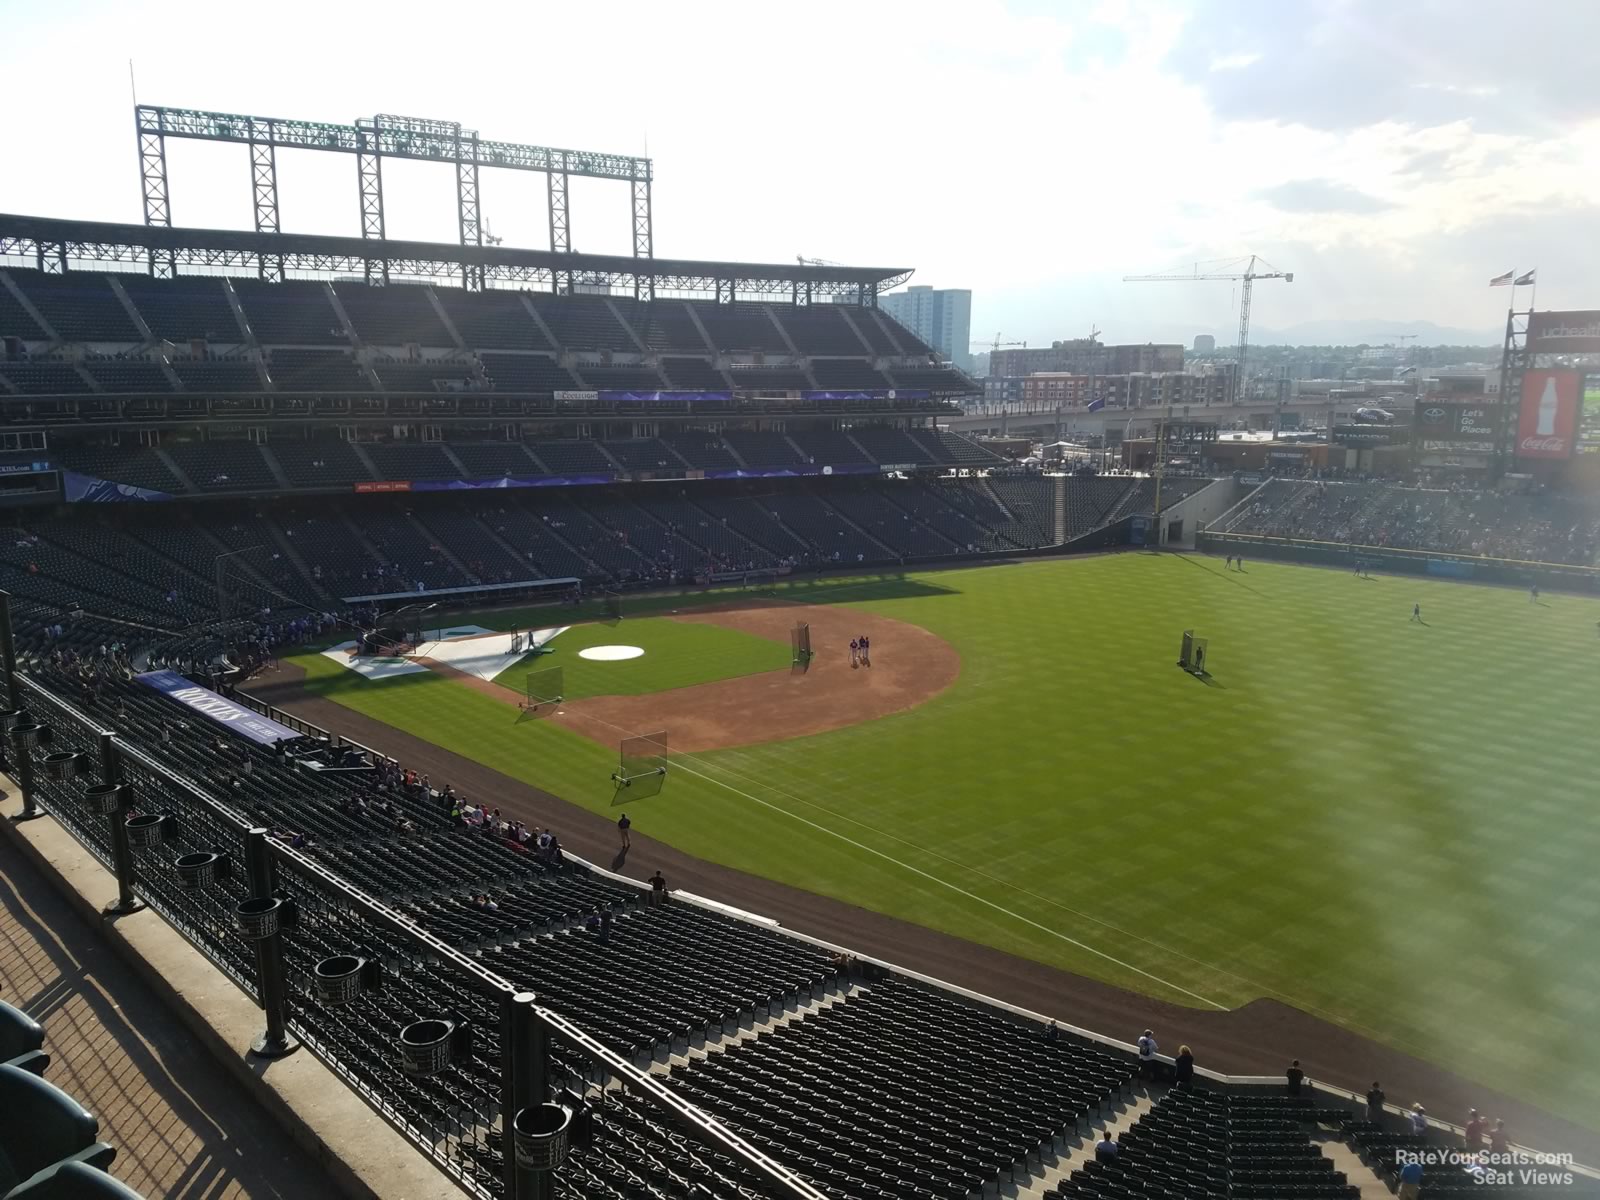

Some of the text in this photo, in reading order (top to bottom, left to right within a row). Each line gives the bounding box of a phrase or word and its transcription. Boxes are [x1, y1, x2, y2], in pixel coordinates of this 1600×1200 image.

[1462, 409, 1485, 417] Let's
[1461, 417, 1475, 425] Go
[1460, 425, 1492, 434] Places
[168, 686, 251, 721] ROCKIES
